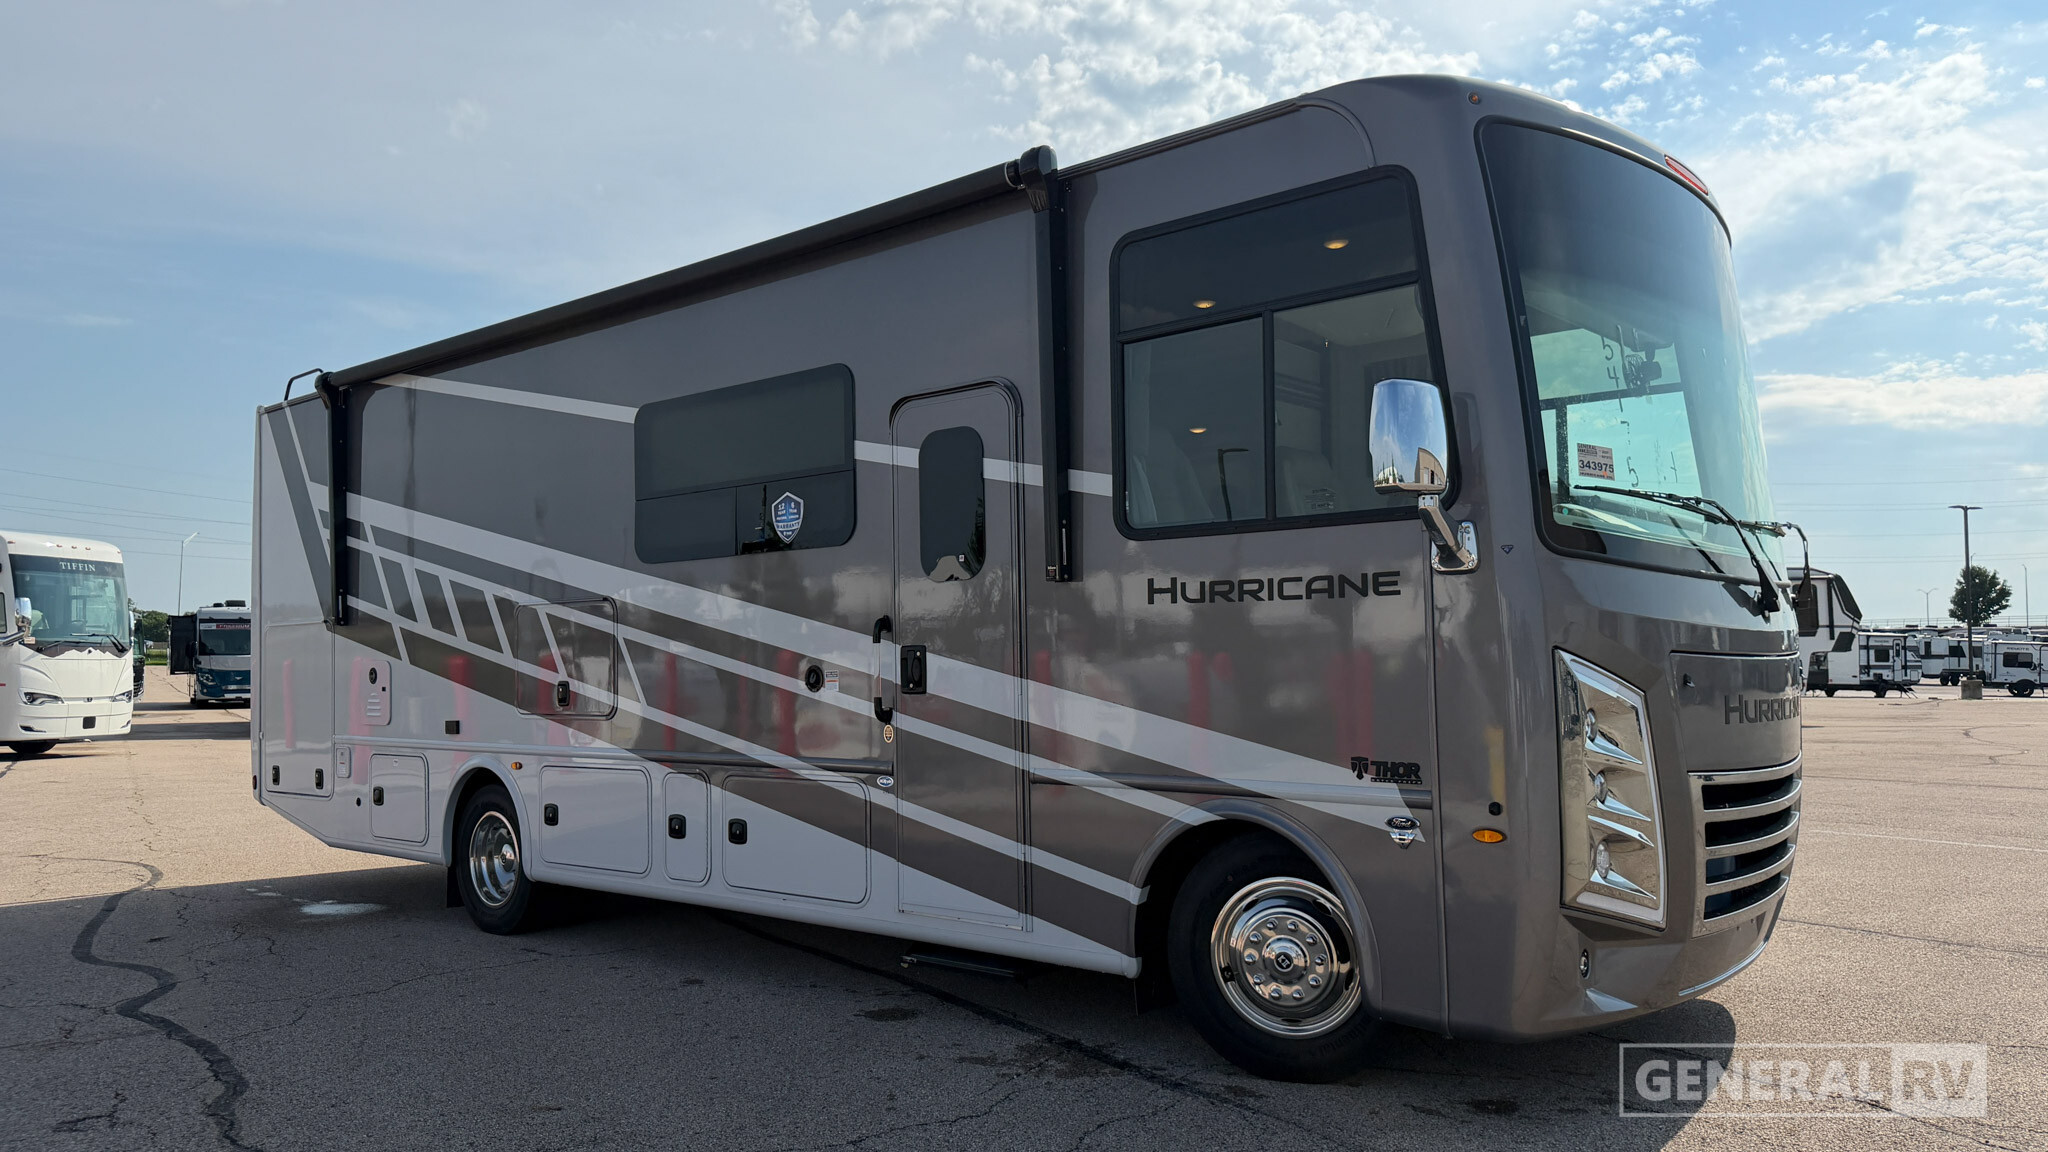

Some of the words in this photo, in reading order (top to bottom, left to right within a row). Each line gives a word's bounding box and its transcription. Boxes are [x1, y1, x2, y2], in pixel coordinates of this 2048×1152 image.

[1579, 459, 1614, 473] 343975
[59, 561, 96, 572] TIFFIN
[1147, 570, 1401, 605] HURRICANE
[1371, 761, 1421, 779] THOR
